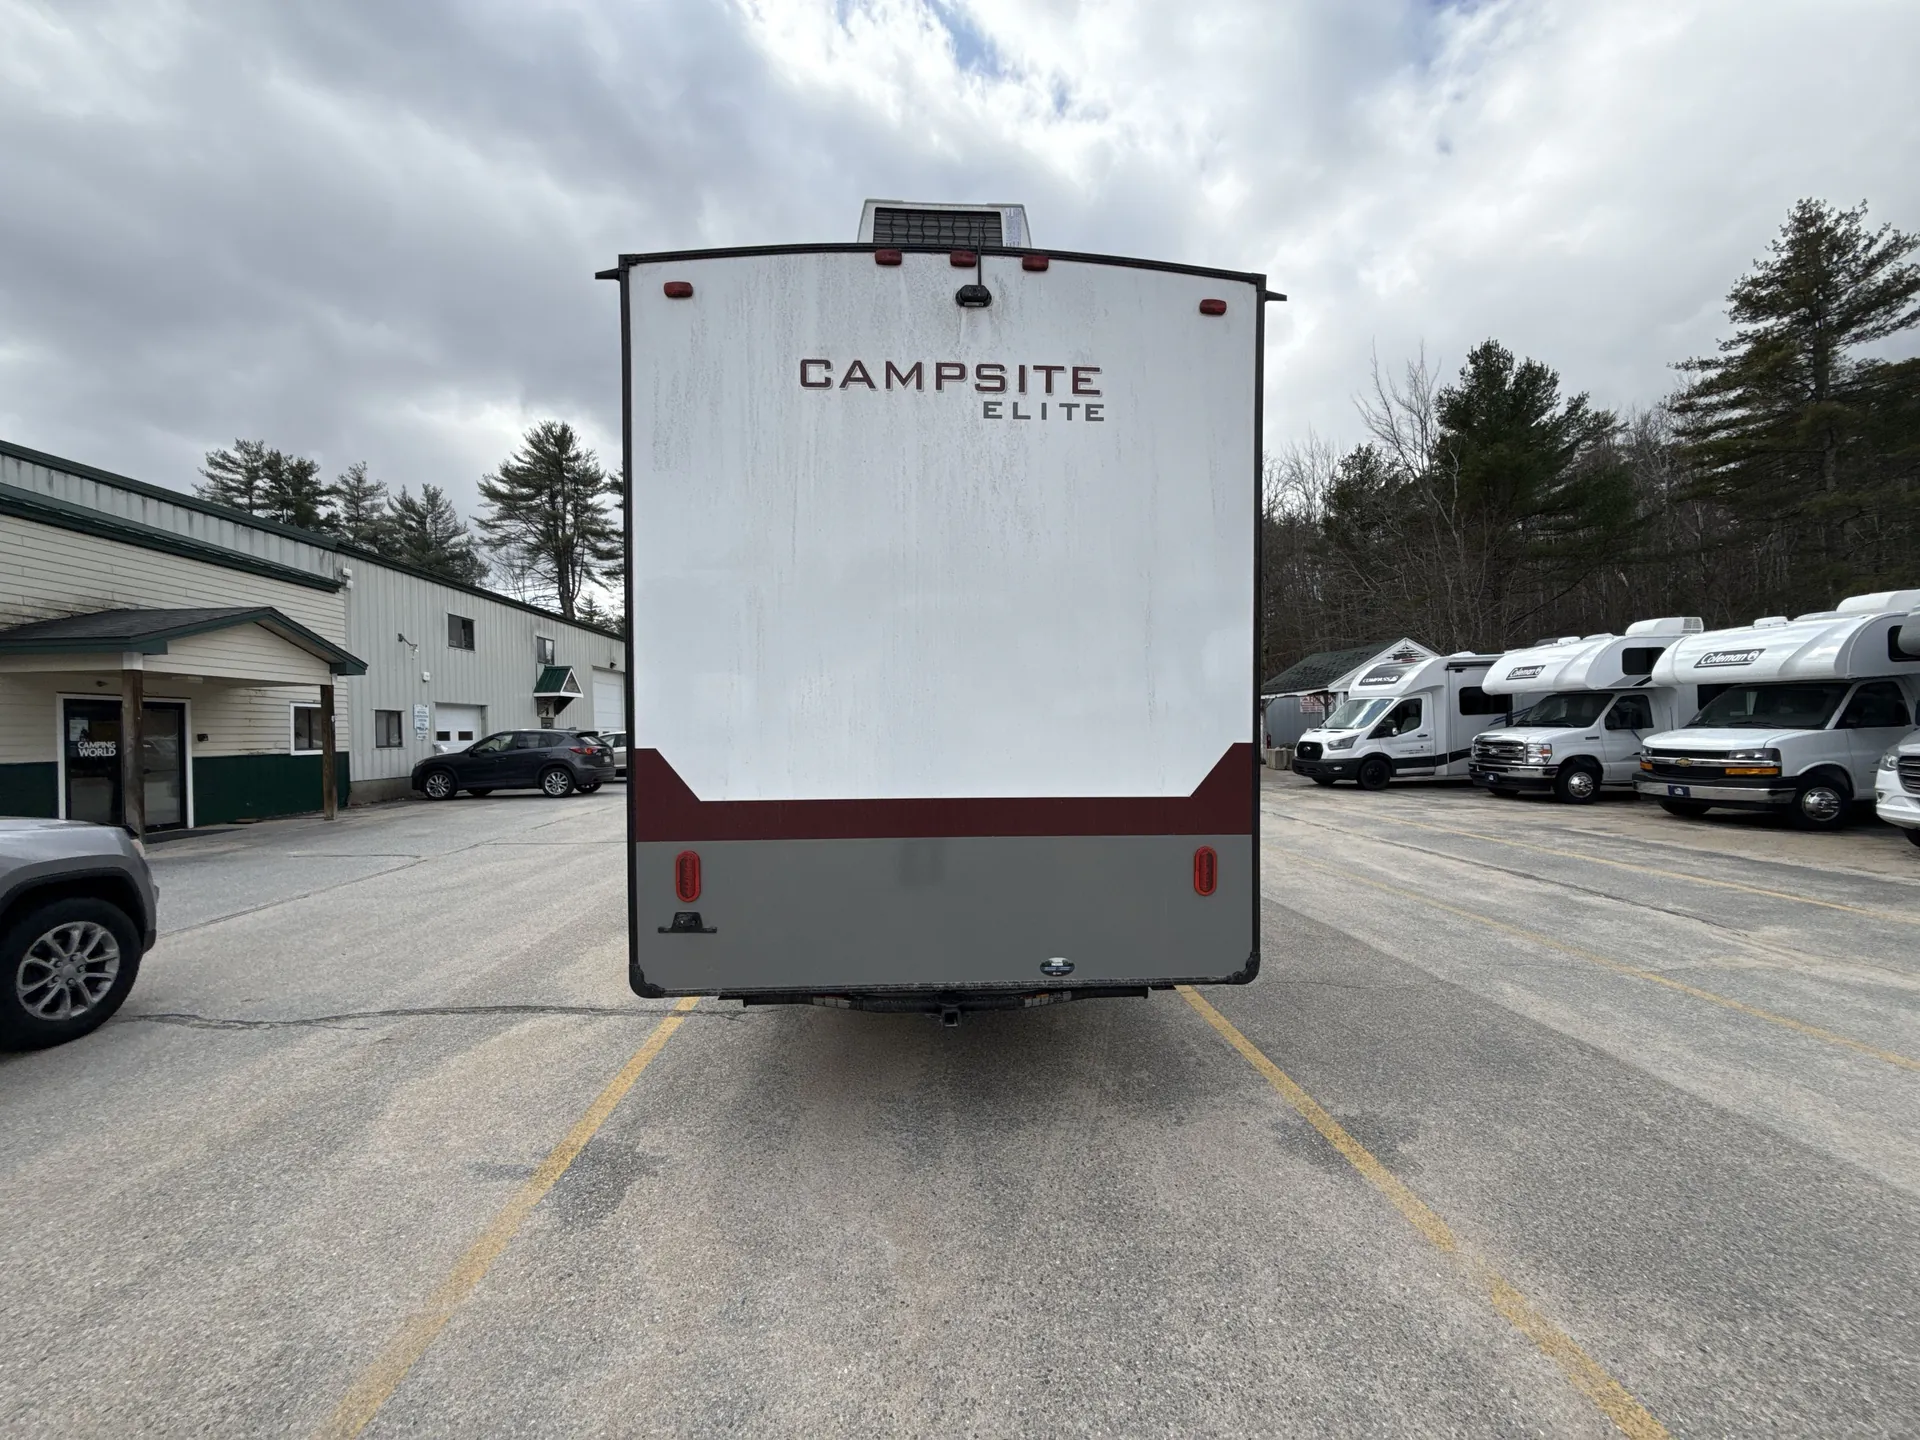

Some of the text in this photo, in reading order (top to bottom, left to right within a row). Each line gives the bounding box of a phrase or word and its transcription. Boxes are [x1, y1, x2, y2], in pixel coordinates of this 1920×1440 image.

[800, 359, 1102, 396] CAMPSITE
[983, 401, 1105, 422] ELITE
[1701, 653, 1748, 664] Coleman
[1510, 668, 1536, 676] Coleman
[77, 741, 117, 749] CAMPING
[78, 748, 117, 757] WORLD
